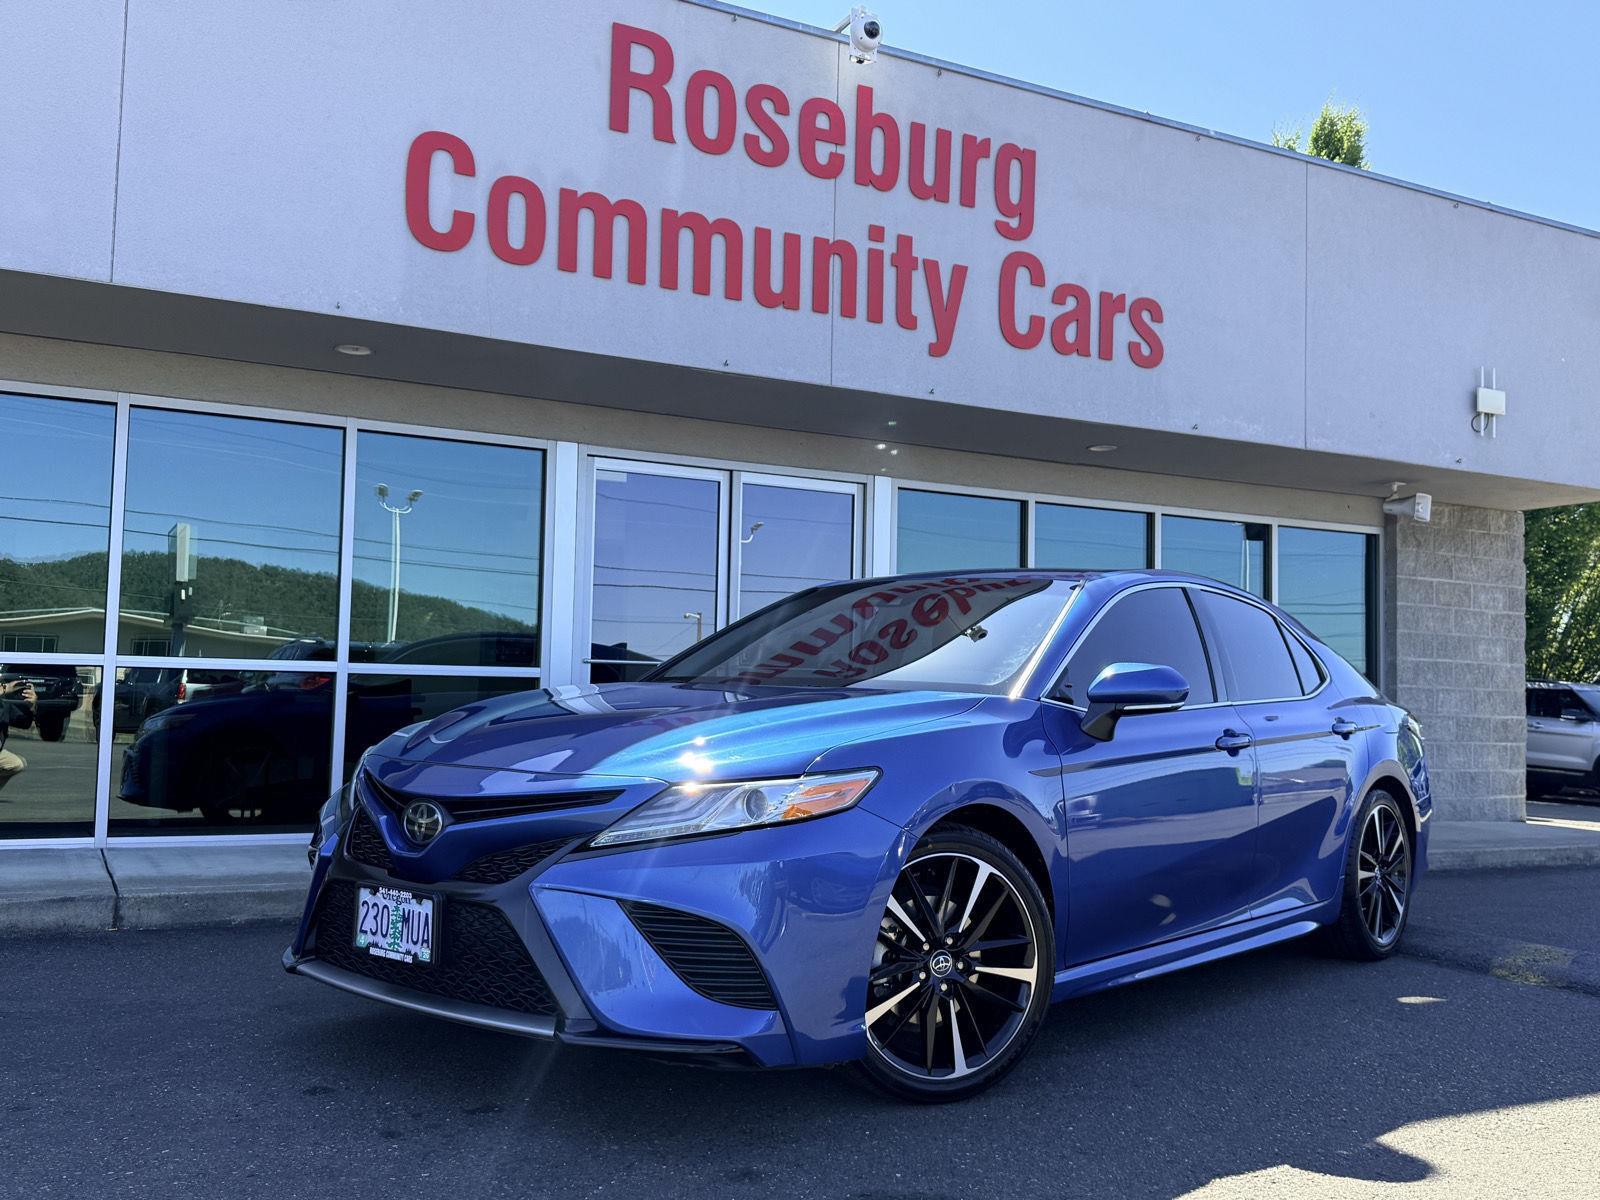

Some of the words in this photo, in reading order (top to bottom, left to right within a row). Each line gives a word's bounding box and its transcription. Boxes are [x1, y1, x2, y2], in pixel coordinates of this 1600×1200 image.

[610, 23, 1036, 240] Roseburg
[406, 131, 967, 357] Community
[999, 251, 1164, 368] Cars
[359, 900, 390, 938] 230
[400, 907, 430, 948] MUA
[382, 891, 411, 905] Oregon
